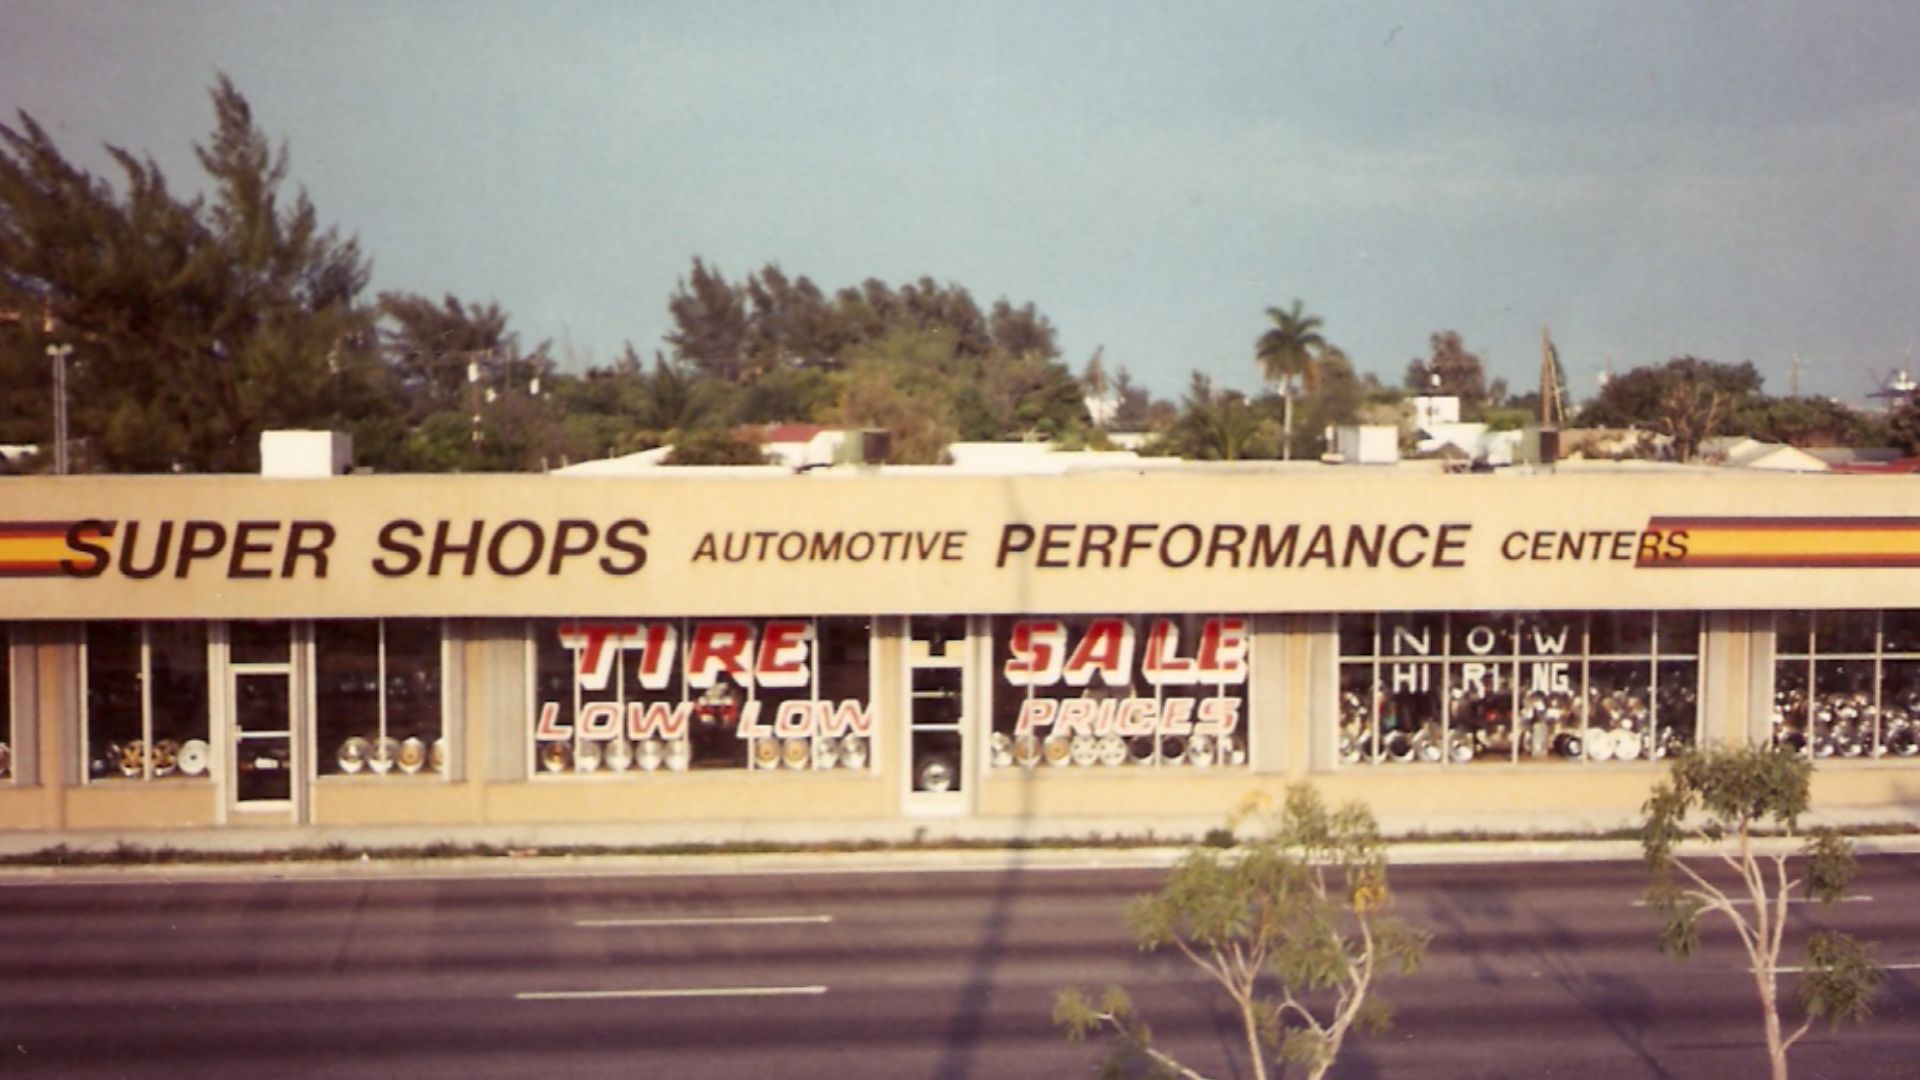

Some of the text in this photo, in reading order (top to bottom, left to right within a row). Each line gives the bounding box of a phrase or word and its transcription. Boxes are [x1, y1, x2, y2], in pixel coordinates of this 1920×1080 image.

[59, 518, 1690, 579] SUPER SHOPS AUTOMOTIVE PERFORMANCE CENTERS
[558, 622, 814, 690] TIRE
[1003, 618, 1249, 686] SALE
[1392, 625, 1569, 655] NOW
[536, 699, 872, 740] LOW LOW
[1014, 698, 1242, 738] PRICES
